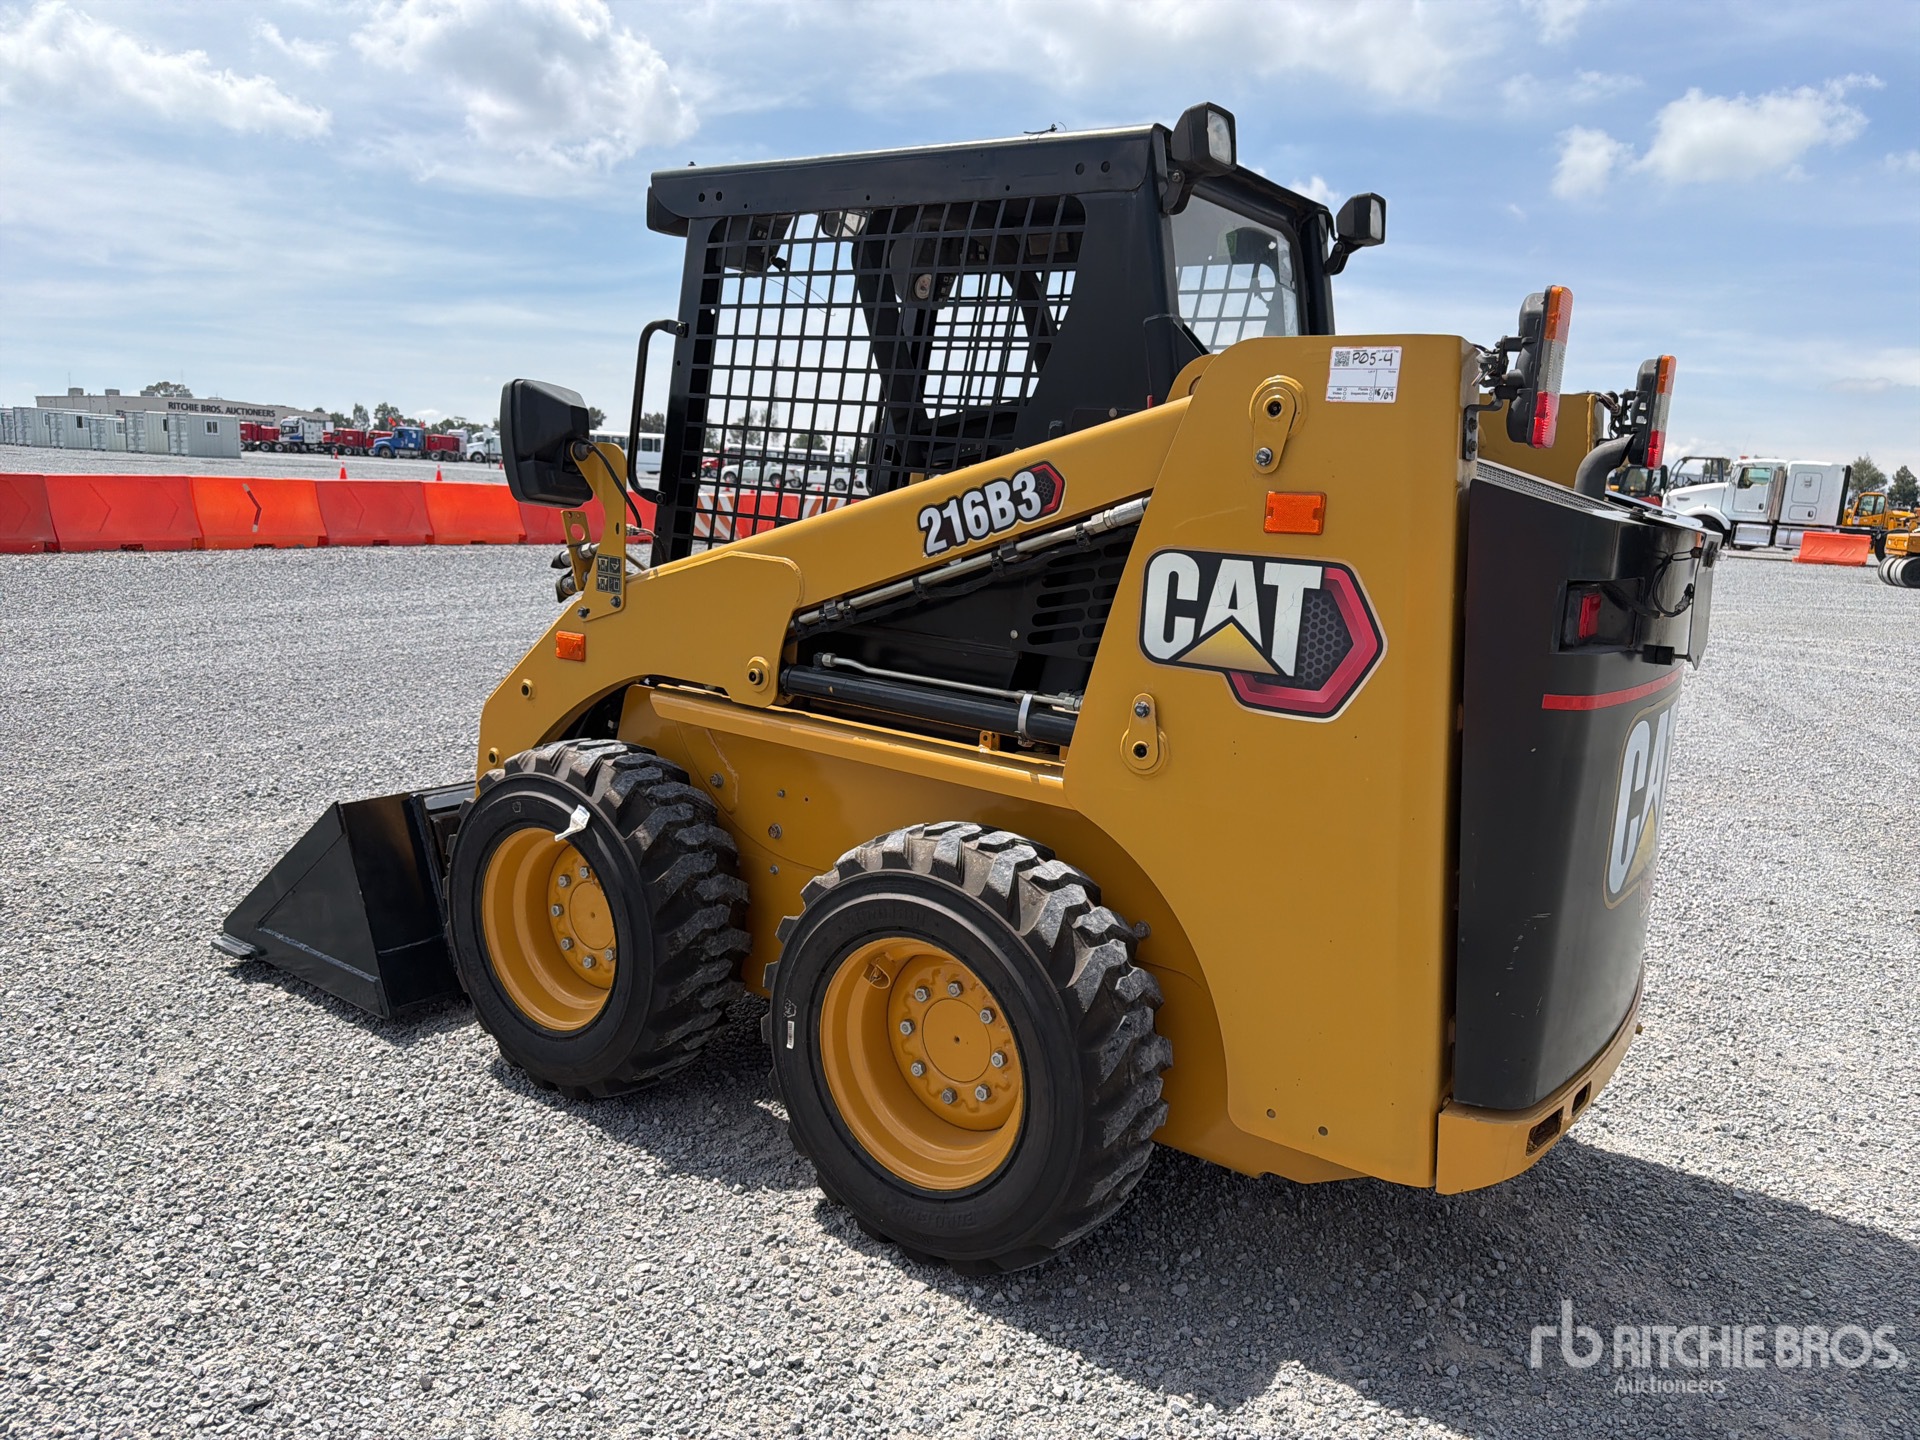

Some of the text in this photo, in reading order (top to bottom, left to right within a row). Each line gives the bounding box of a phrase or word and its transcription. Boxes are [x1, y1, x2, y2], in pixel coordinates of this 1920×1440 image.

[167, 401, 276, 417] RITCHIE BROS. AUCTIONEERS
[919, 470, 1042, 554] 216B3
[1143, 552, 1323, 677] CAT
